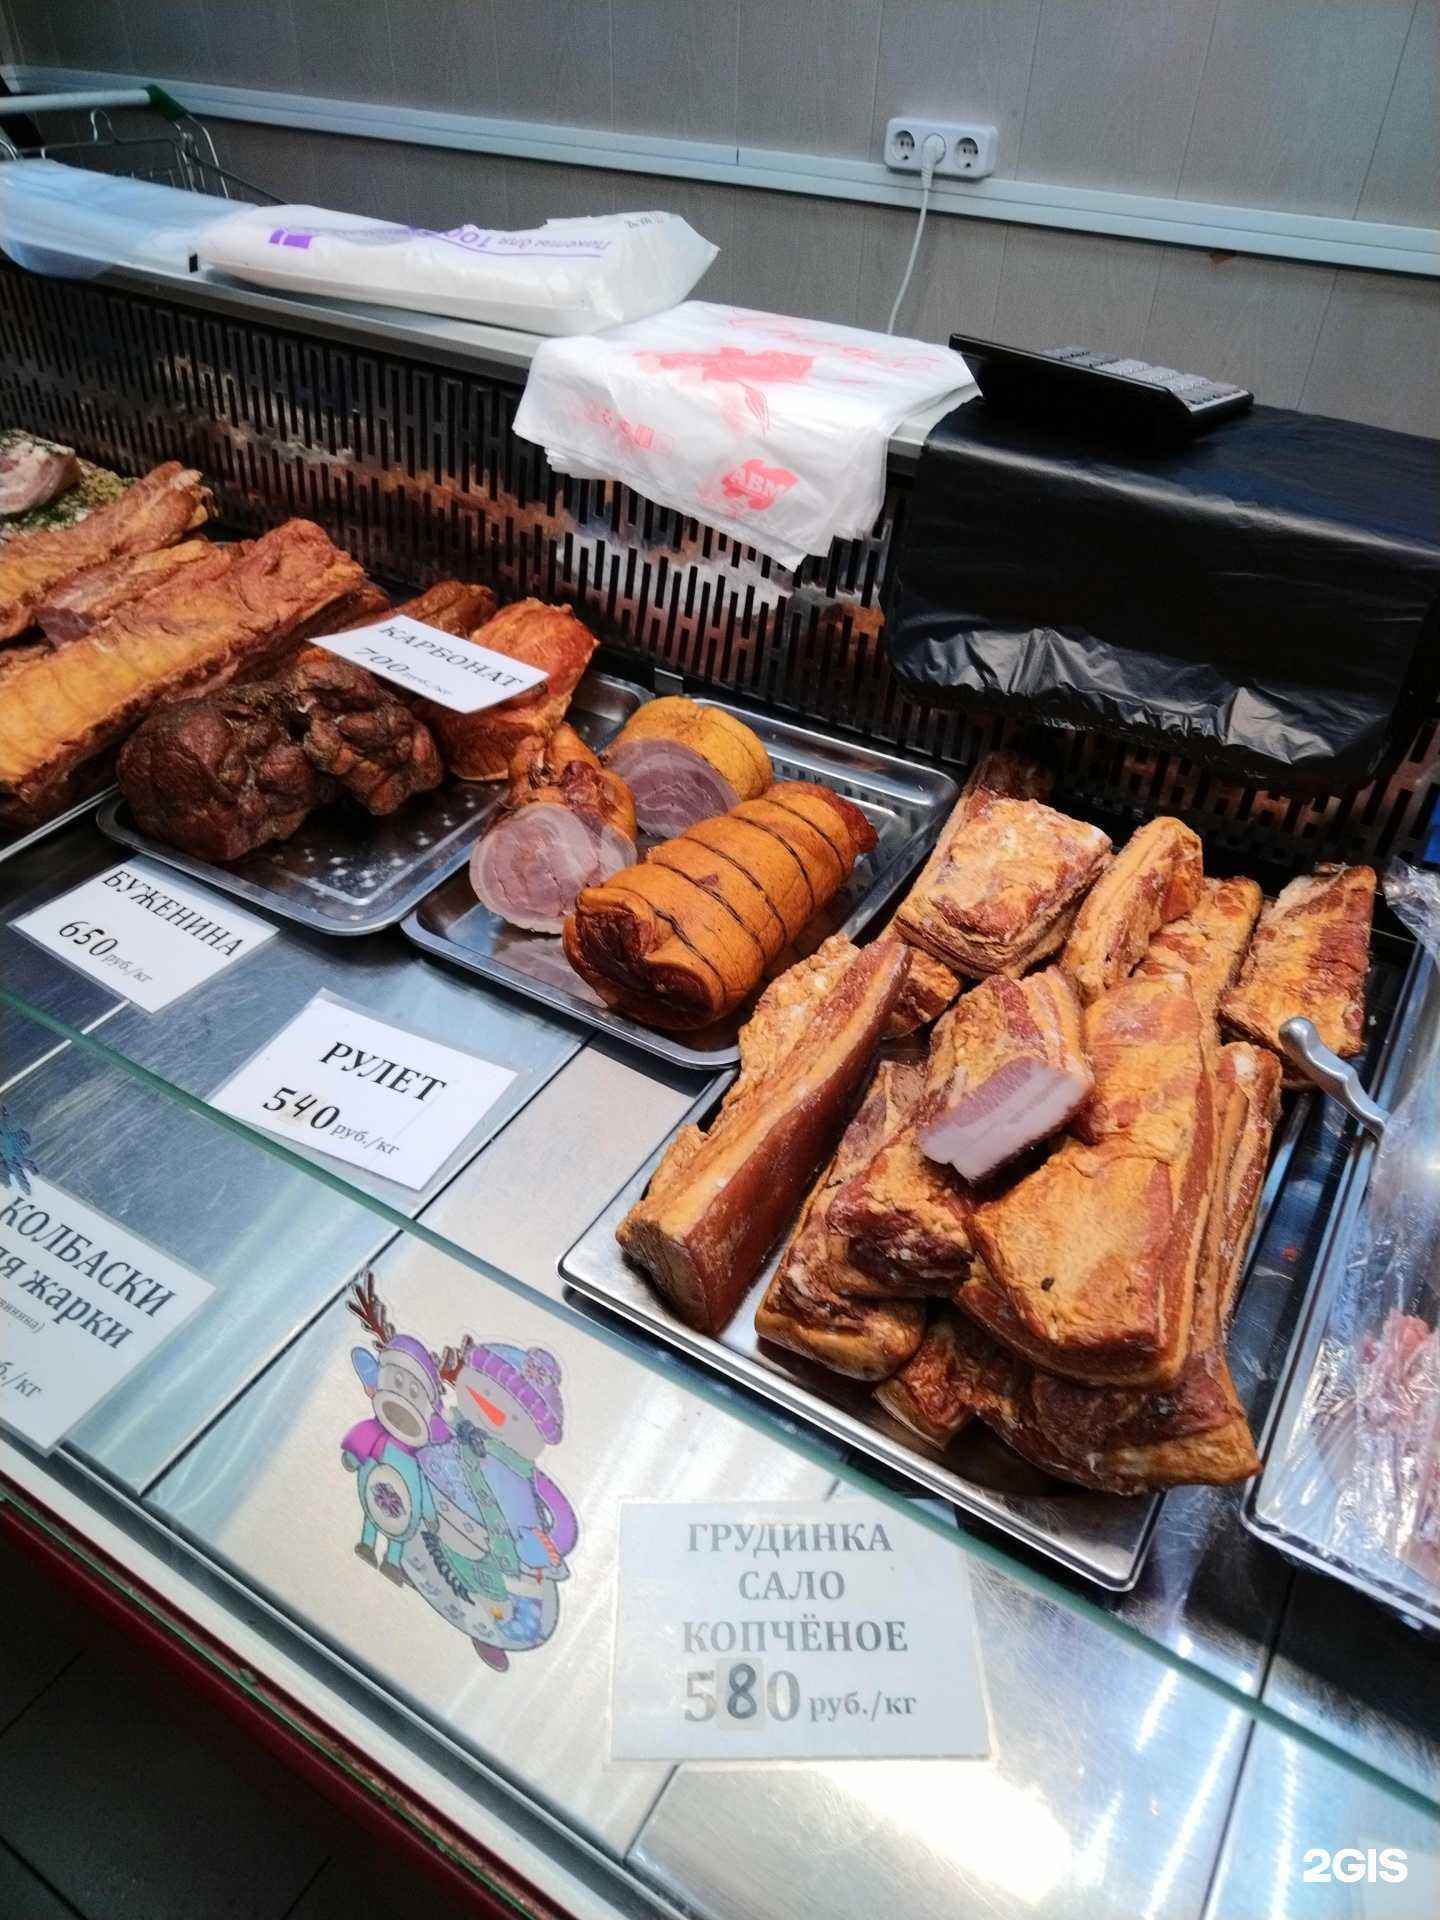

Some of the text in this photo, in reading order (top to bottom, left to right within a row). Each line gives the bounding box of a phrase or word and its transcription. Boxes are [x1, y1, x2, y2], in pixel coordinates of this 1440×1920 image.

[379, 625, 524, 688] КАРБОНАТ
[102, 869, 244, 957] БУЖЕНИНА
[318, 1041, 448, 1102] РУЛЕТ
[262, 1086, 341, 1130] 540
[0, 1196, 177, 1318] КОЛБАСКИ
[18, 1268, 135, 1349] жарки
[687, 1522, 894, 1558] ГРУДИНКА
[738, 1569, 846, 1601] САЛО
[681, 1613, 910, 1653] КОПЧЁНОЕ
[684, 1662, 917, 1723] 580 руб./кг
